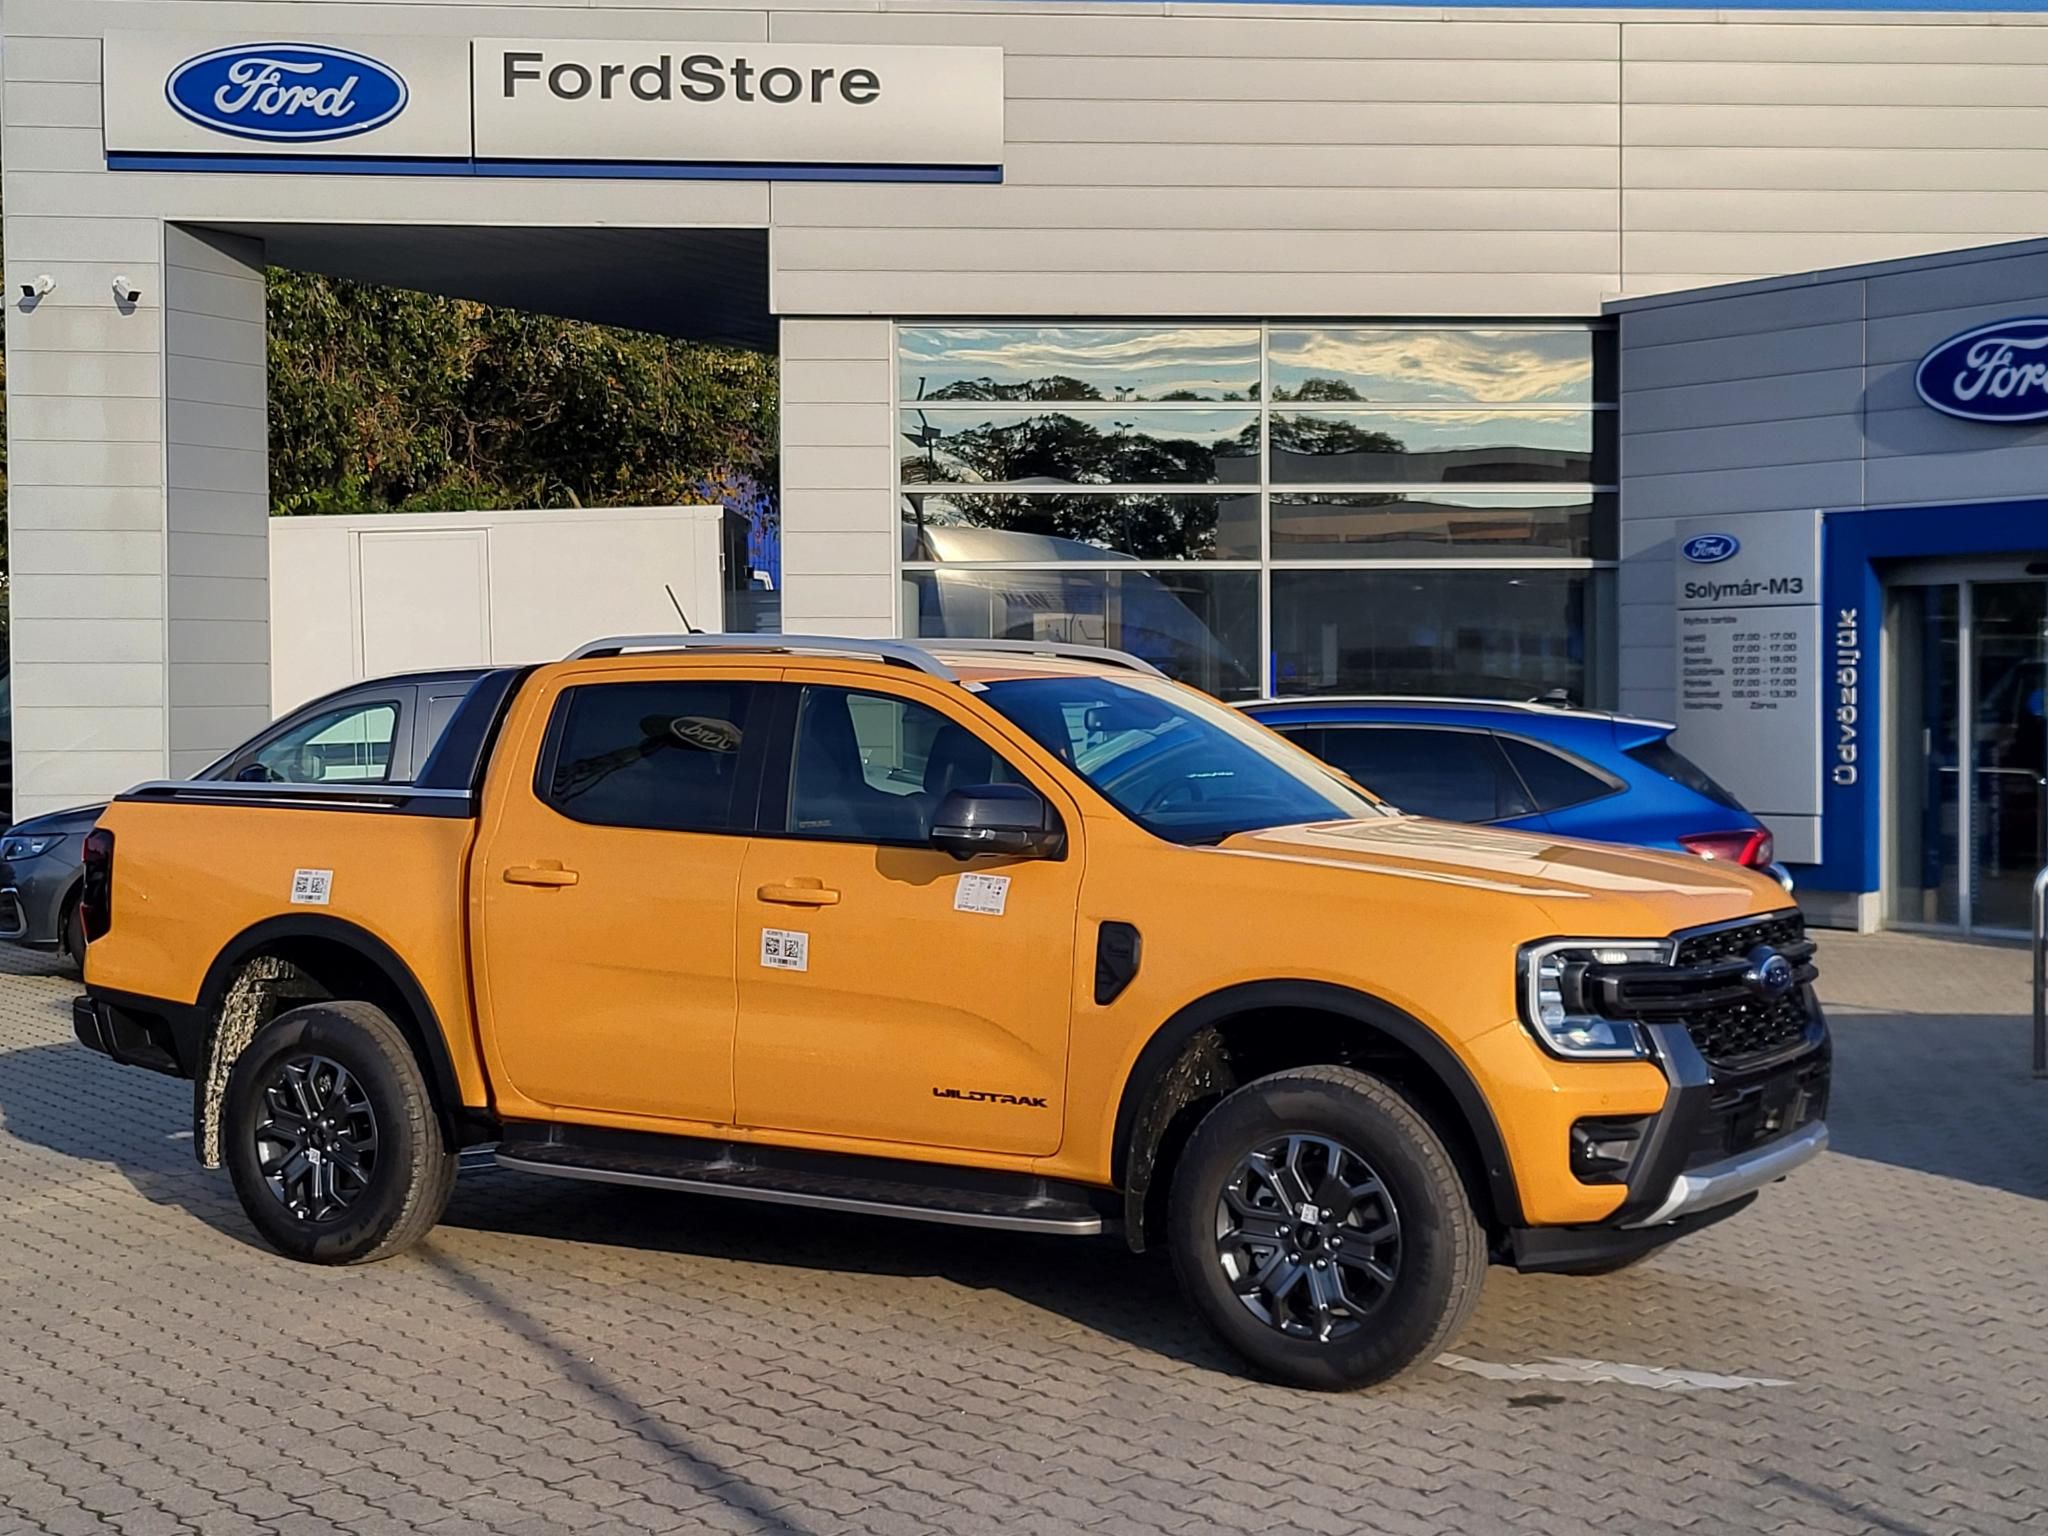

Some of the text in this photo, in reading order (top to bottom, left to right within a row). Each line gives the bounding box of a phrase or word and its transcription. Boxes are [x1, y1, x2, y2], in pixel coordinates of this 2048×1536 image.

[213, 57, 359, 118] Ford
[502, 51, 882, 105] FordStore
[1953, 337, 2048, 401] For
[1691, 539, 1725, 557] Ford
[1684, 577, 1804, 601] Solymár-M3
[1732, 633, 1760, 642] 07.00
[1769, 632, 1797, 641] 17.00
[1732, 645, 1760, 653] 07.00
[1769, 643, 1797, 652] 17.00
[1732, 656, 1760, 665] 07.00
[1732, 667, 1760, 676] 07.00
[1769, 667, 1797, 675] 17.00
[1732, 679, 1760, 688] 07.00
[1769, 678, 1797, 687] 17.00
[1832, 608, 1861, 786] Üdvözöljük
[932, 1087, 1048, 1108] WILDTRAK
